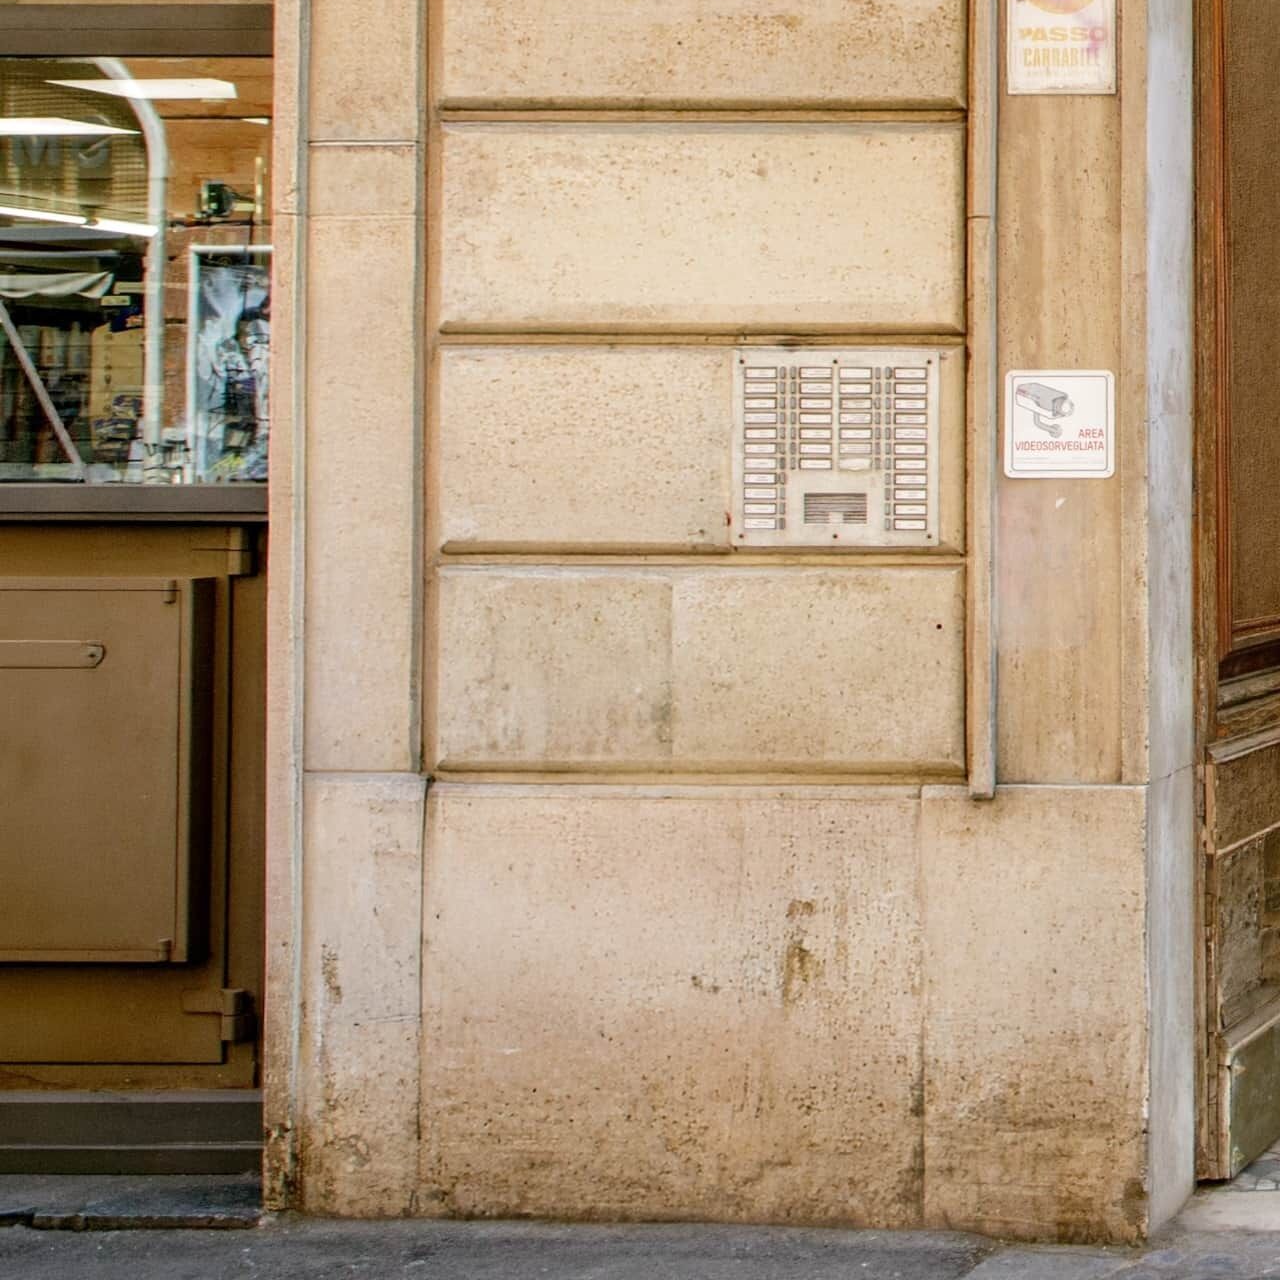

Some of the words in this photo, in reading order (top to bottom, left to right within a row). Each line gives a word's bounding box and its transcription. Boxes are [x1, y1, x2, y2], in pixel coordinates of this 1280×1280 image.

[1018, 26, 1109, 42] PASSO
[1078, 428, 1105, 439] AREA
[1015, 440, 1105, 451] VIDEOSORVEGLIATA
